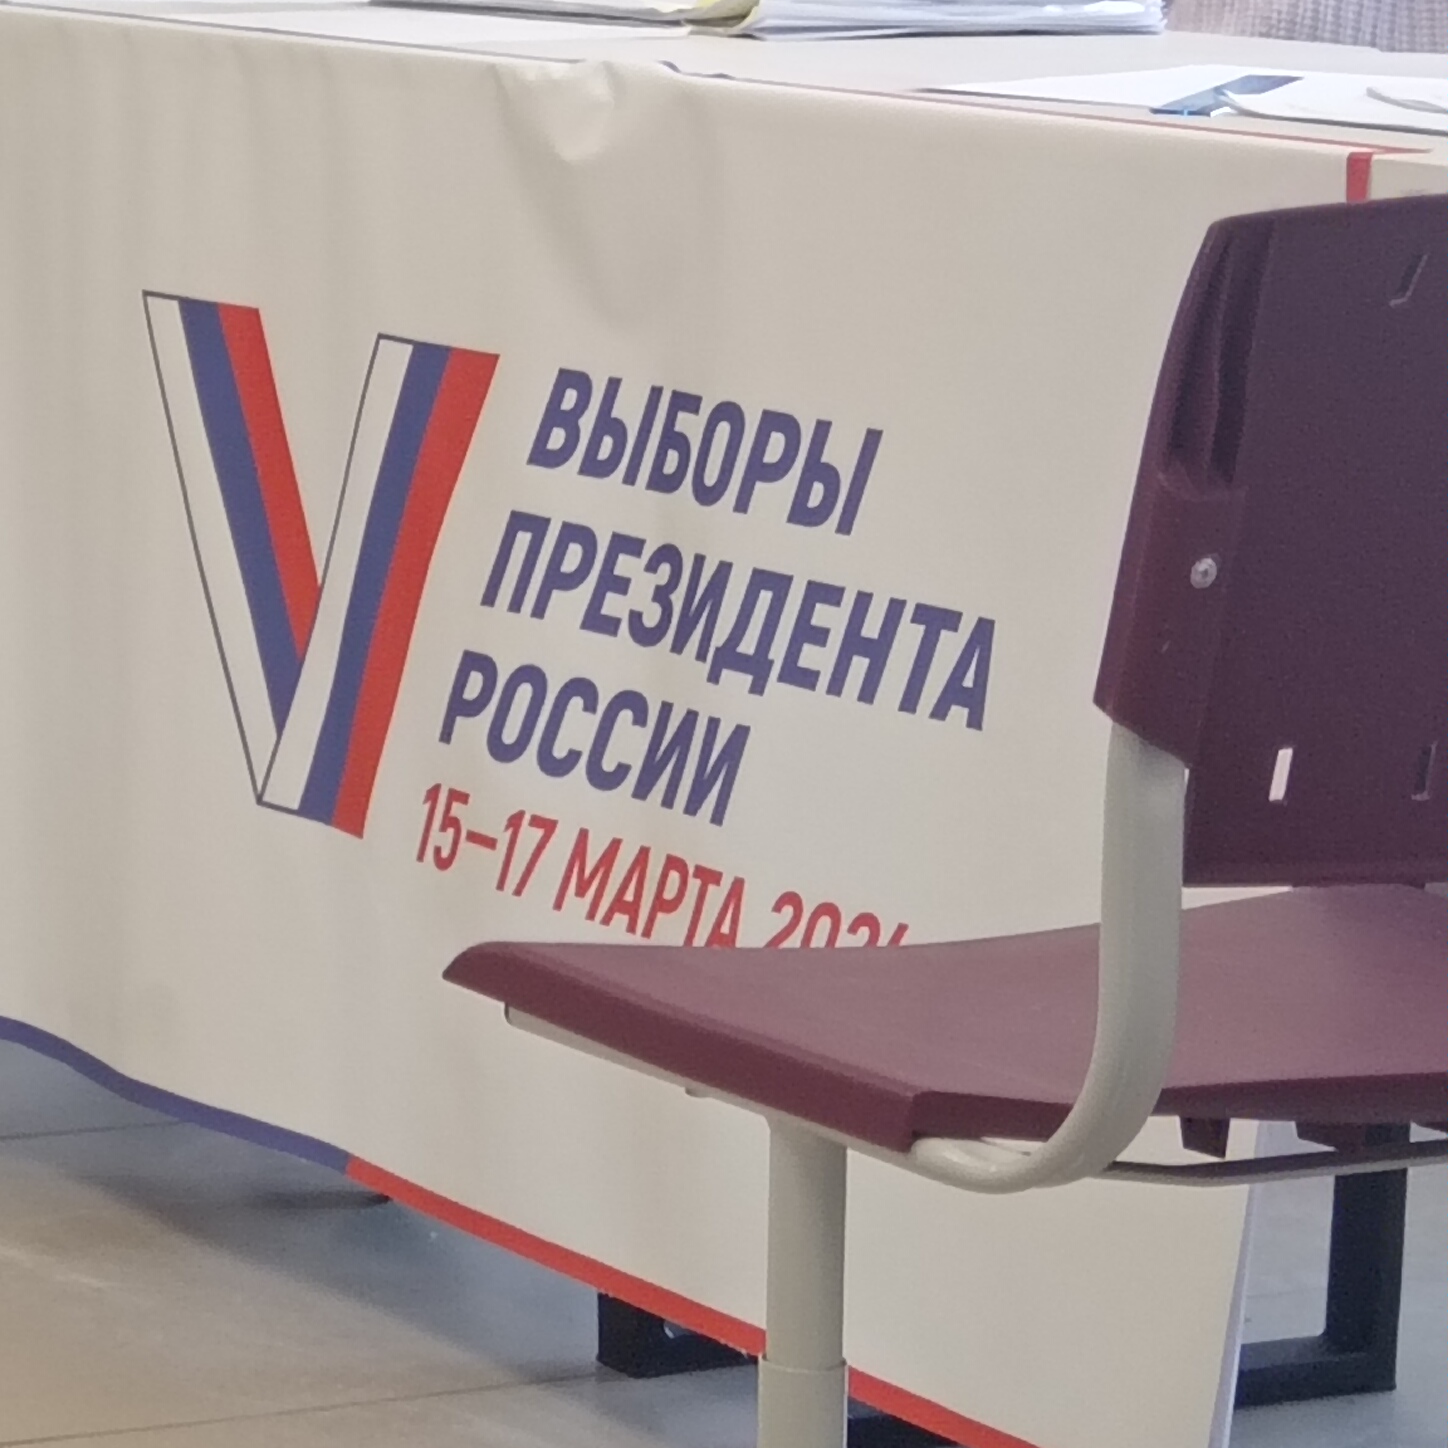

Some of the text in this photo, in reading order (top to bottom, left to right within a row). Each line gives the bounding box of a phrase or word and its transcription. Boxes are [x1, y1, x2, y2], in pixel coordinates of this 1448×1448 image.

[526, 367, 884, 536] ВЫБОРЫ
[480, 509, 996, 731] ПРЕЗИДЕНТА
[438, 649, 752, 827] РОССИИ
[552, 827, 746, 948] МАРТА
